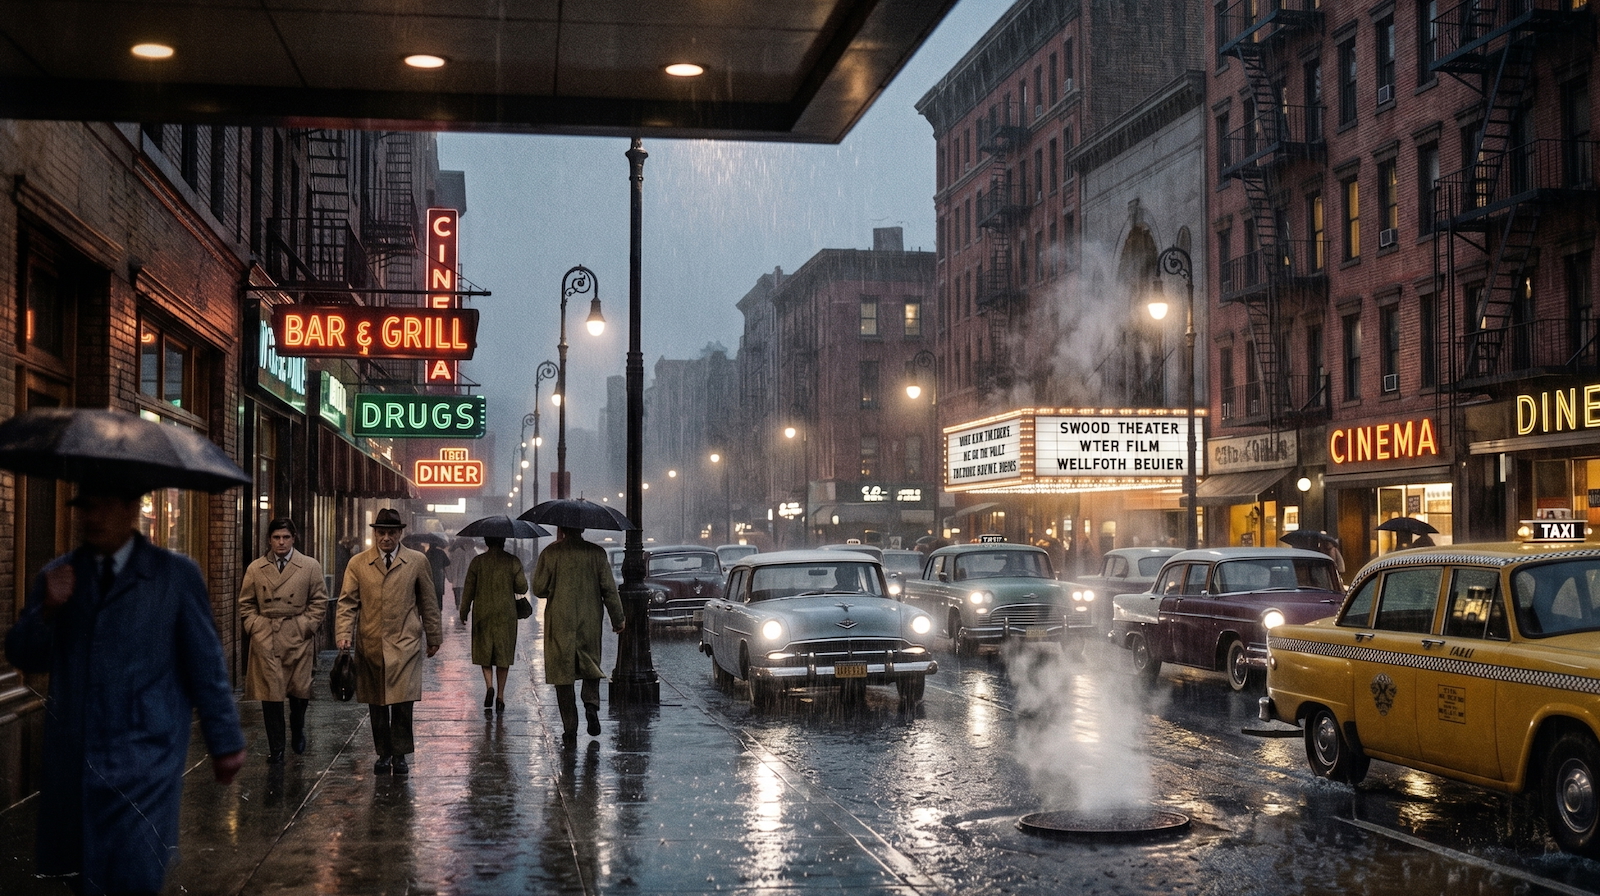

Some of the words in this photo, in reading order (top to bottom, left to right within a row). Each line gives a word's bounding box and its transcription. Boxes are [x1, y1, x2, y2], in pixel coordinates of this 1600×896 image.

[430, 216, 452, 380] CINEA
[285, 315, 346, 346] BAR
[382, 316, 468, 350] GRILL
[361, 402, 475, 430] DRUGS
[1516, 384, 1600, 436] DINE
[1060, 421, 1111, 435] SWOOD
[1118, 421, 1179, 435] THEATER
[1079, 440, 1119, 453] WTER
[1126, 440, 1159, 453] FILM
[1330, 418, 1437, 464] CINEMA
[420, 465, 478, 482] DINER
[1057, 457, 1126, 471] WELLFOTH
[1134, 457, 1184, 471] BEUIER
[1541, 524, 1575, 538] TAXI
